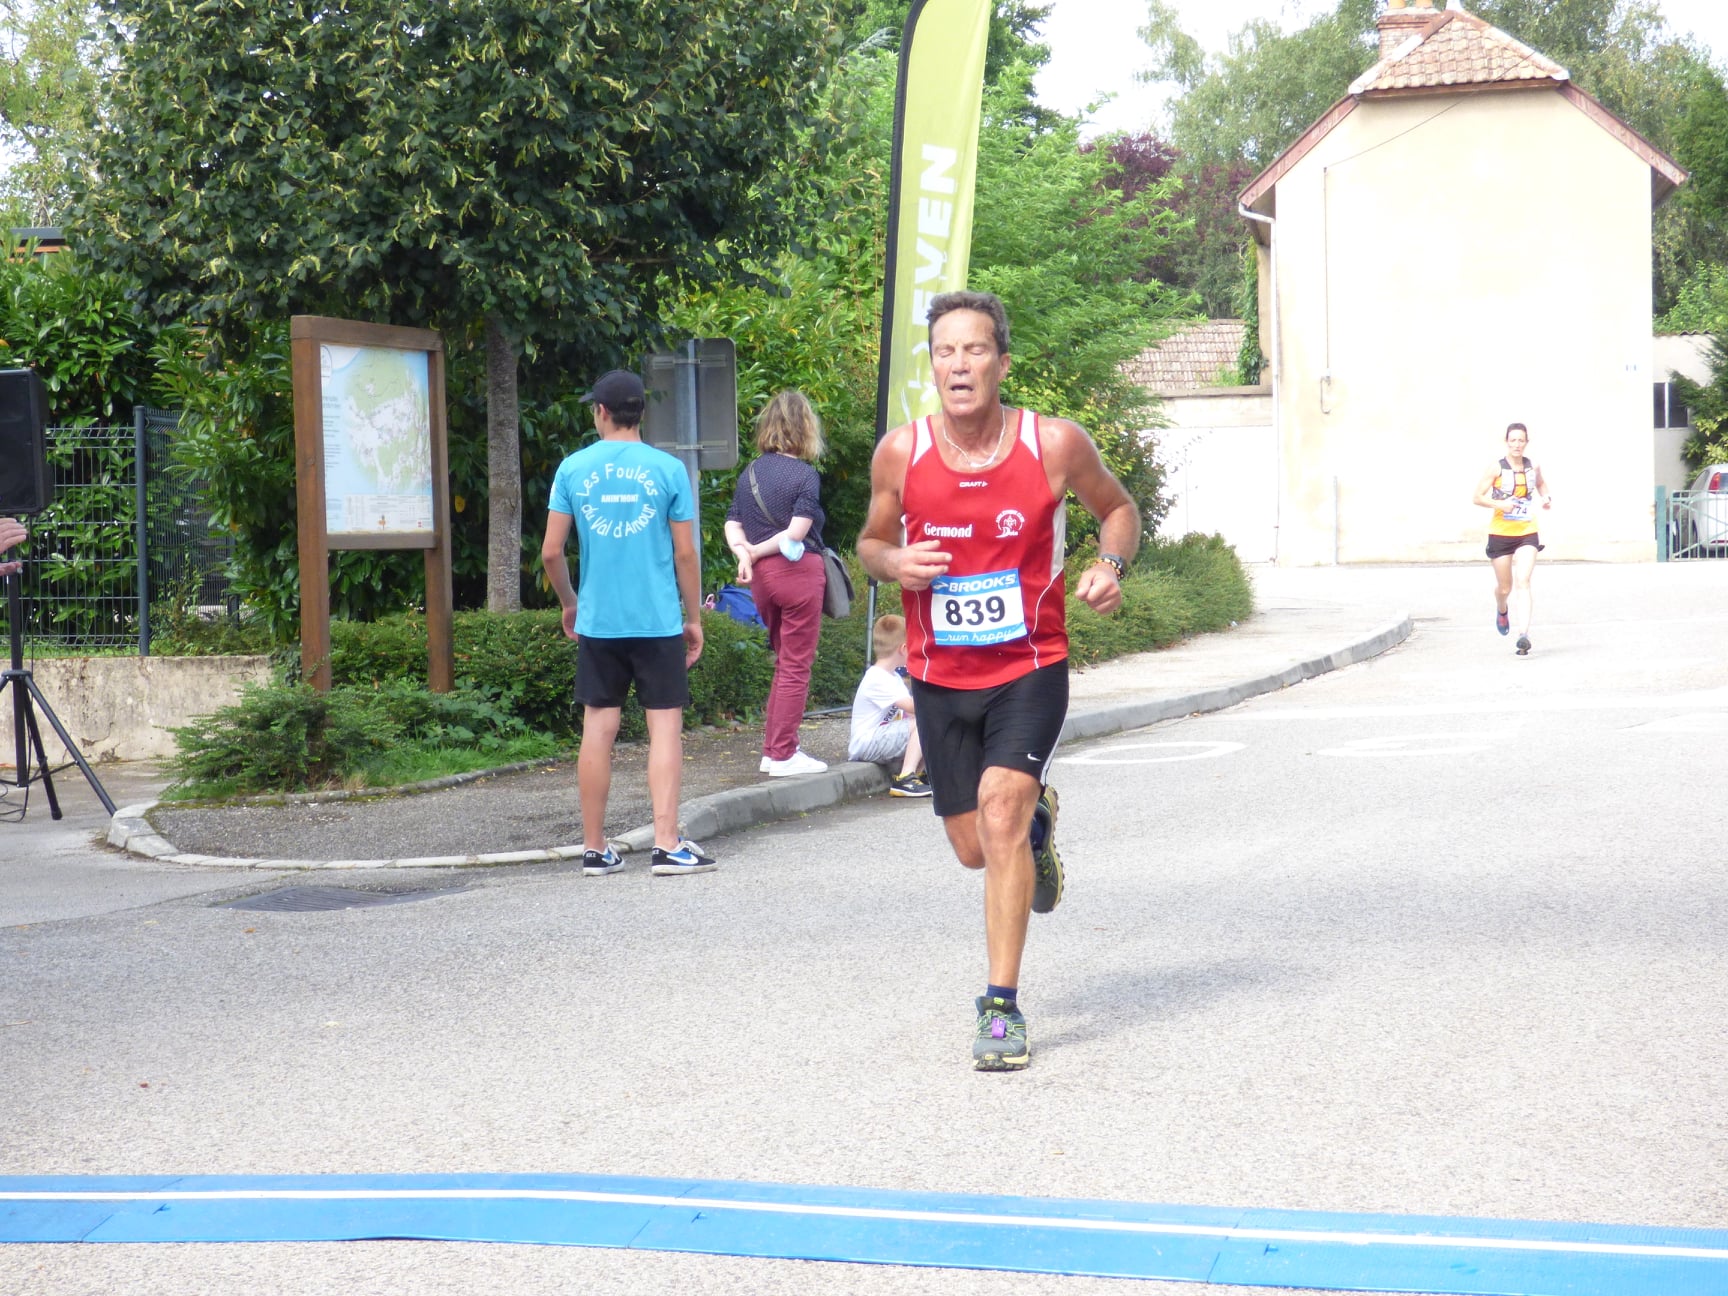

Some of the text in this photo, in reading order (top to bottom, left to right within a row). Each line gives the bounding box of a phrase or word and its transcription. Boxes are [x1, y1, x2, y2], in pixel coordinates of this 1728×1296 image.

[575, 463, 659, 497] Les Foulées
[581, 504, 599, 521] du
[590, 515, 613, 536] Val
[923, 522, 973, 538] Germond
[948, 573, 1017, 593] BROOKS
[944, 595, 1006, 626] 839
[945, 629, 1012, 645] run happy
